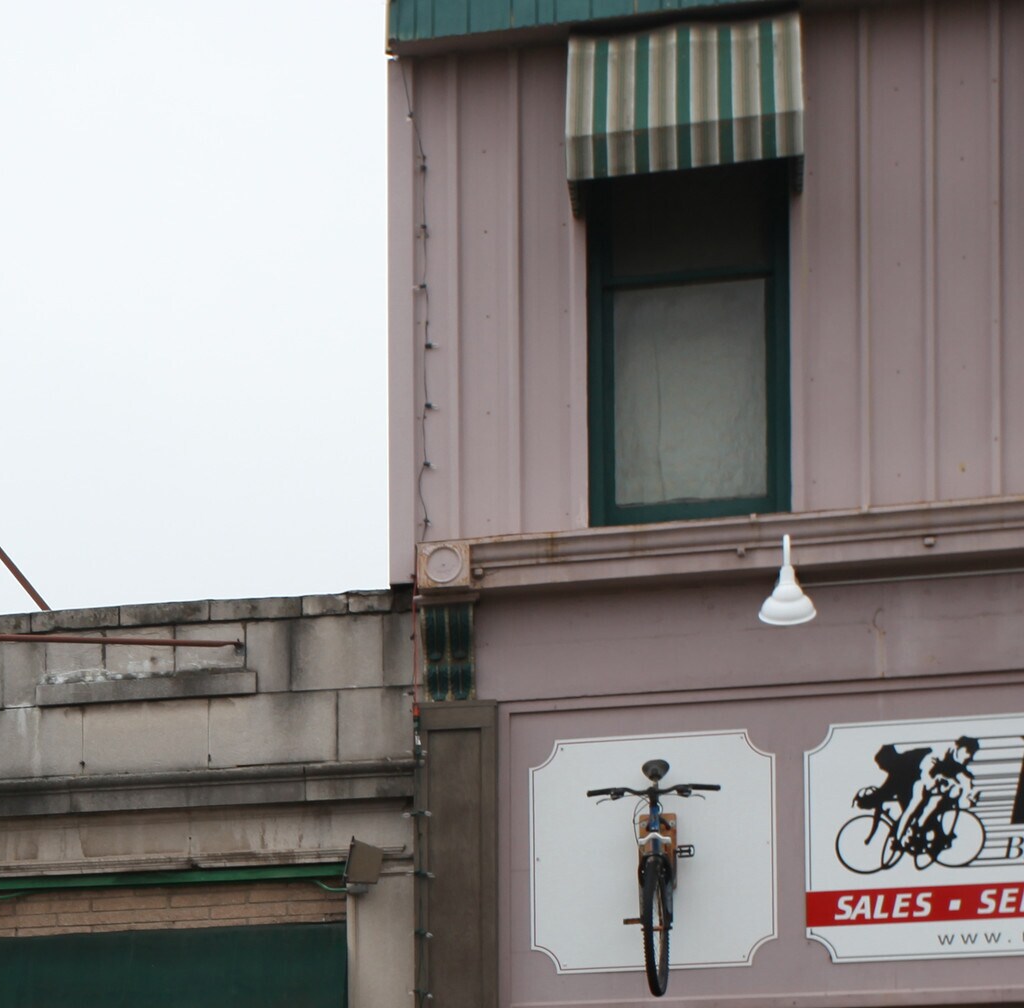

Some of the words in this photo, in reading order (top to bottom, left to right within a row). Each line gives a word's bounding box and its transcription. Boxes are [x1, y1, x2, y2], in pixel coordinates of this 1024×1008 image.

[833, 892, 933, 921] SALES
[977, 887, 1024, 915] SE
[937, 932, 1024, 946] www.
